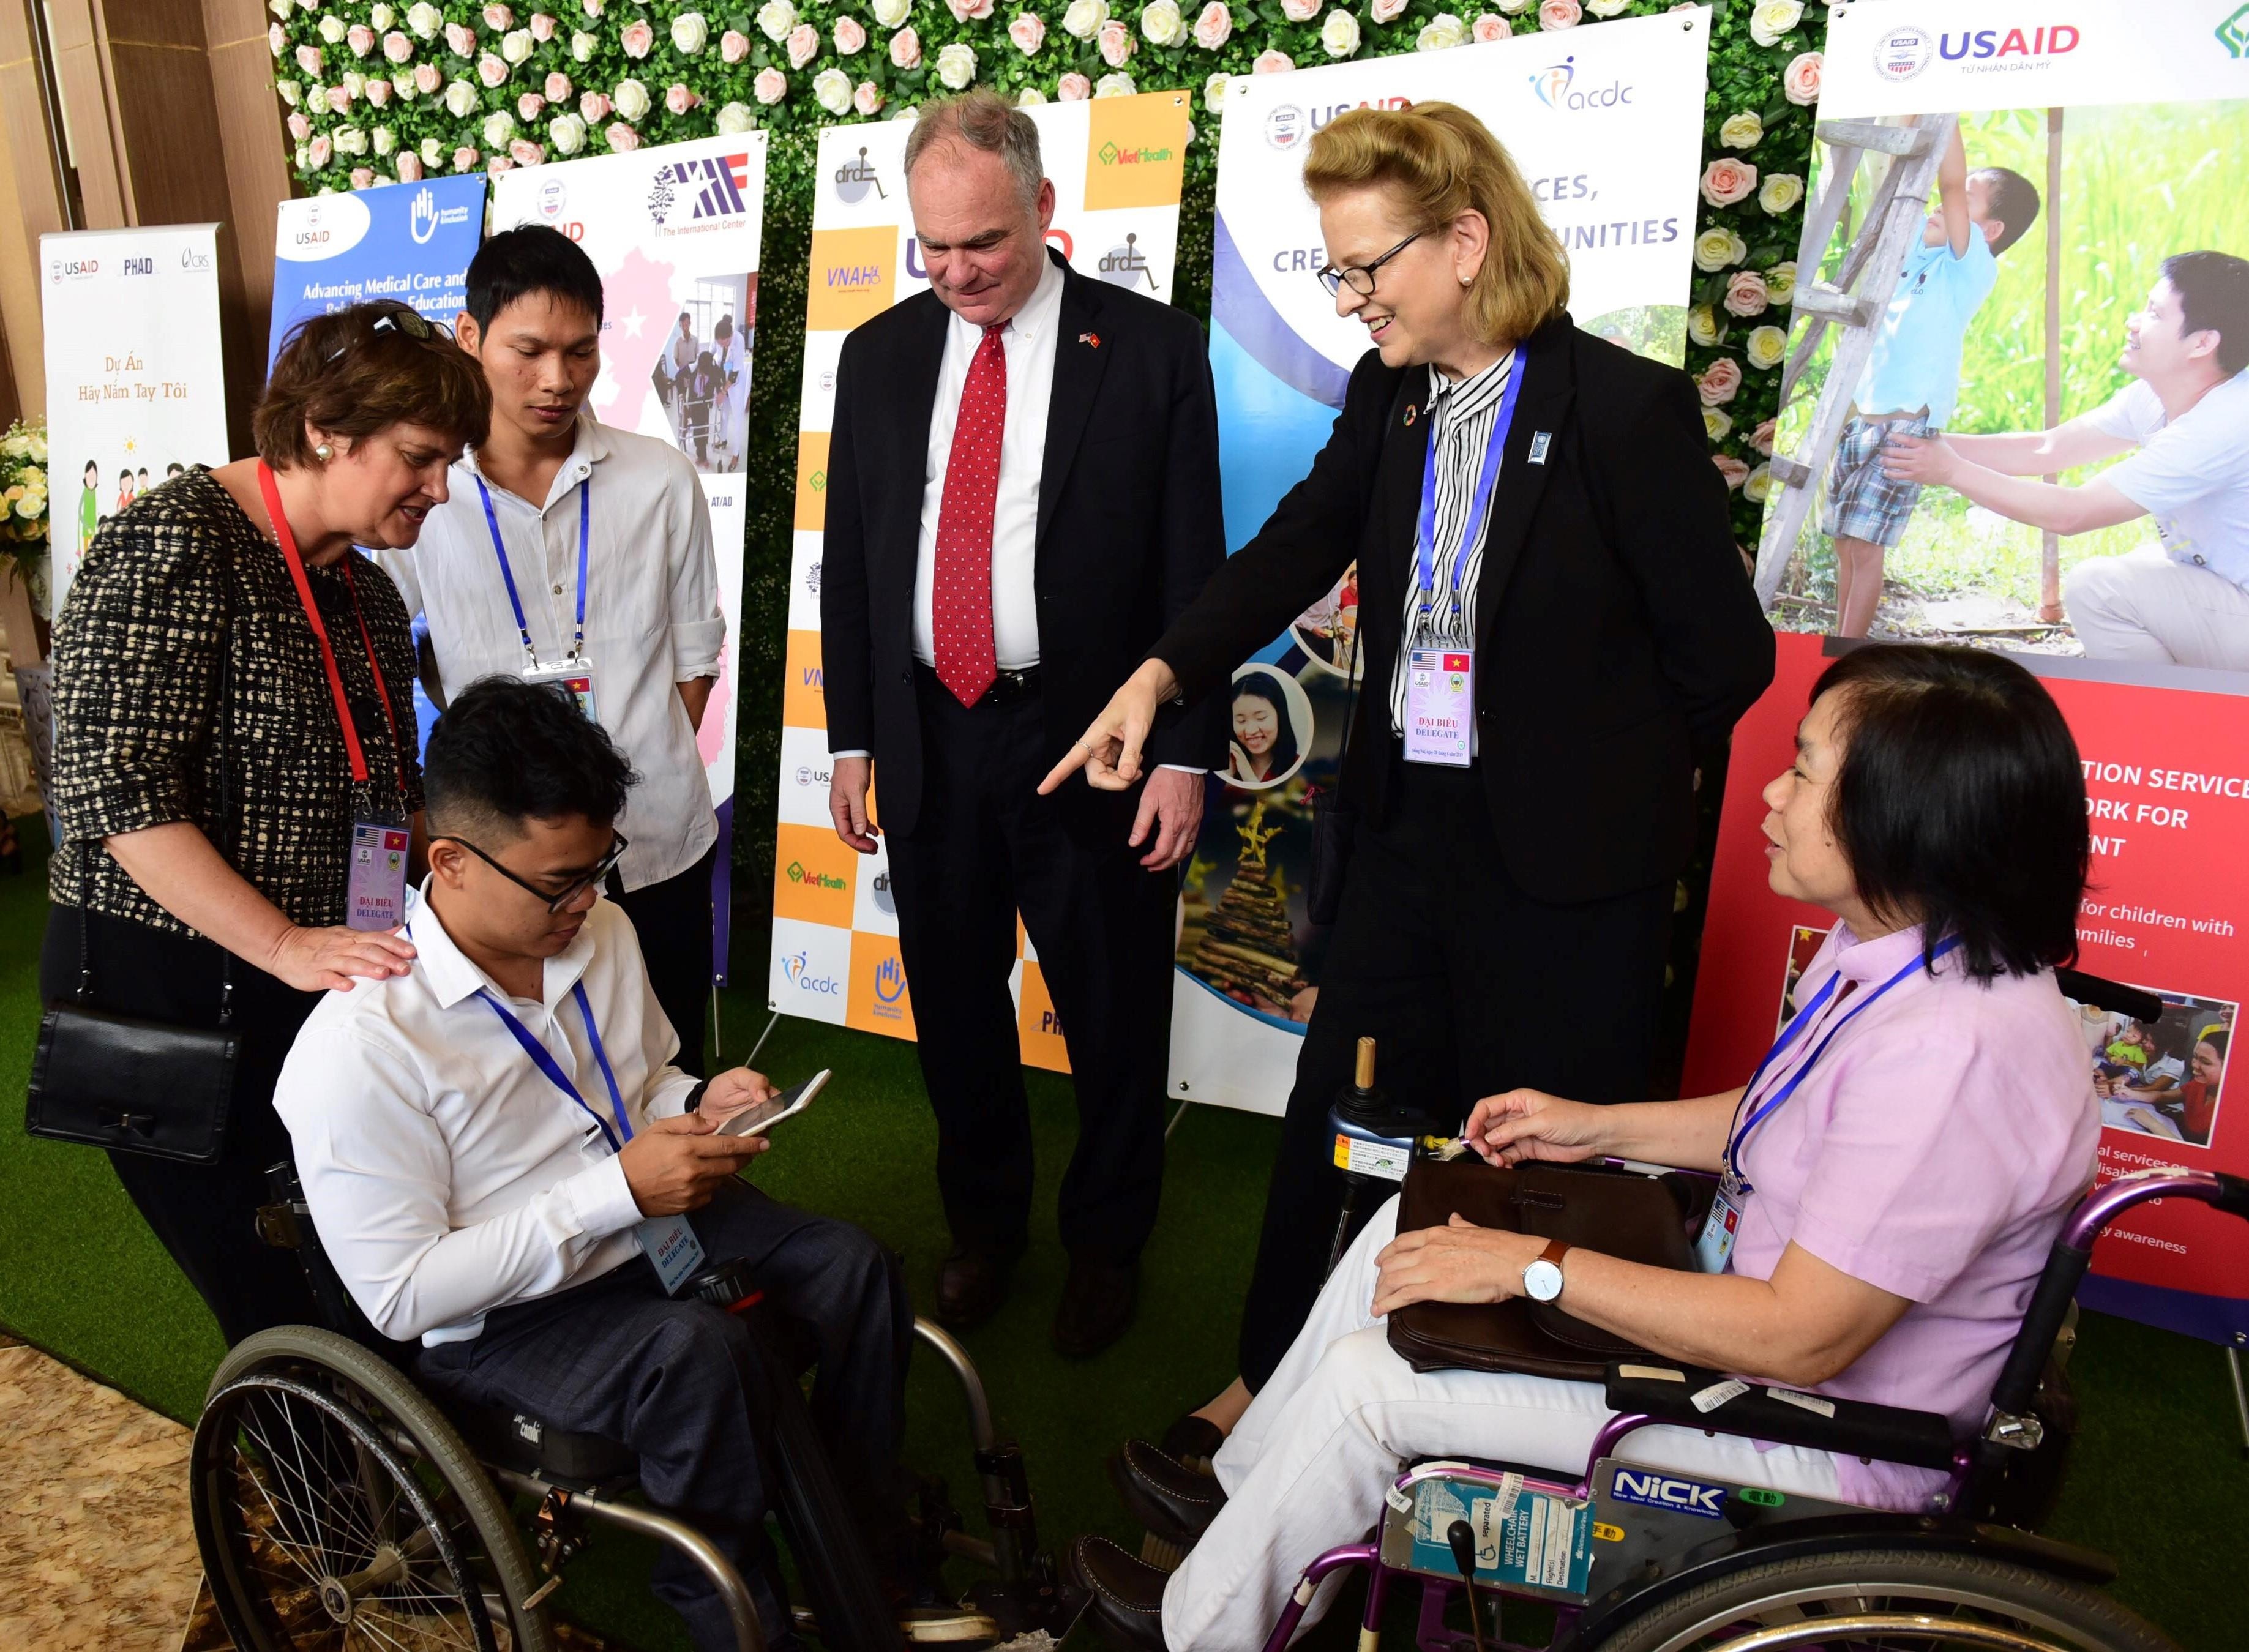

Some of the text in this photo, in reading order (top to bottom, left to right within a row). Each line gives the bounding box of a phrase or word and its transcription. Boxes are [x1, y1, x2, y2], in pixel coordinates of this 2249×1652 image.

[1939, 25, 2080, 61] USAID
[1568, 80, 1633, 111] acdc
[1117, 148, 1173, 165] VietHealth
[296, 231, 330, 245] USAID
[663, 220, 746, 237] The International Center
[1552, 218, 1679, 249] UNITIES
[65, 260, 98, 275] USAID
[124, 258, 152, 275] PHAD
[192, 255, 209, 268] CRS
[303, 267, 468, 299] Advancing Medical Care and
[125, 350, 143, 370] Án
[134, 384, 155, 402] Tay
[162, 383, 187, 399] Tôi
[711, 496, 733, 507] AT/AD
[1416, 728, 1459, 739] DELEGATE
[2136, 804, 2189, 829] FOR
[803, 870, 846, 891] VietHealth
[357, 909, 394, 919] DELEGATE
[2080, 898, 2234, 936] for children with
[2075, 927, 2136, 949] milies
[801, 976, 839, 995] acdc
[2112, 1149, 2168, 1168] services
[2114, 1228, 2187, 1254] awareness
[661, 1235, 689, 1269] DELEGATE
[1647, 1498, 1674, 1508] Creation
[1482, 1502, 1491, 1538] separated
[1515, 1509, 1529, 1568] WET BATTERY
[1546, 1559, 1555, 1584] Flight(s)
[1557, 1551, 1566, 1585] Destination
